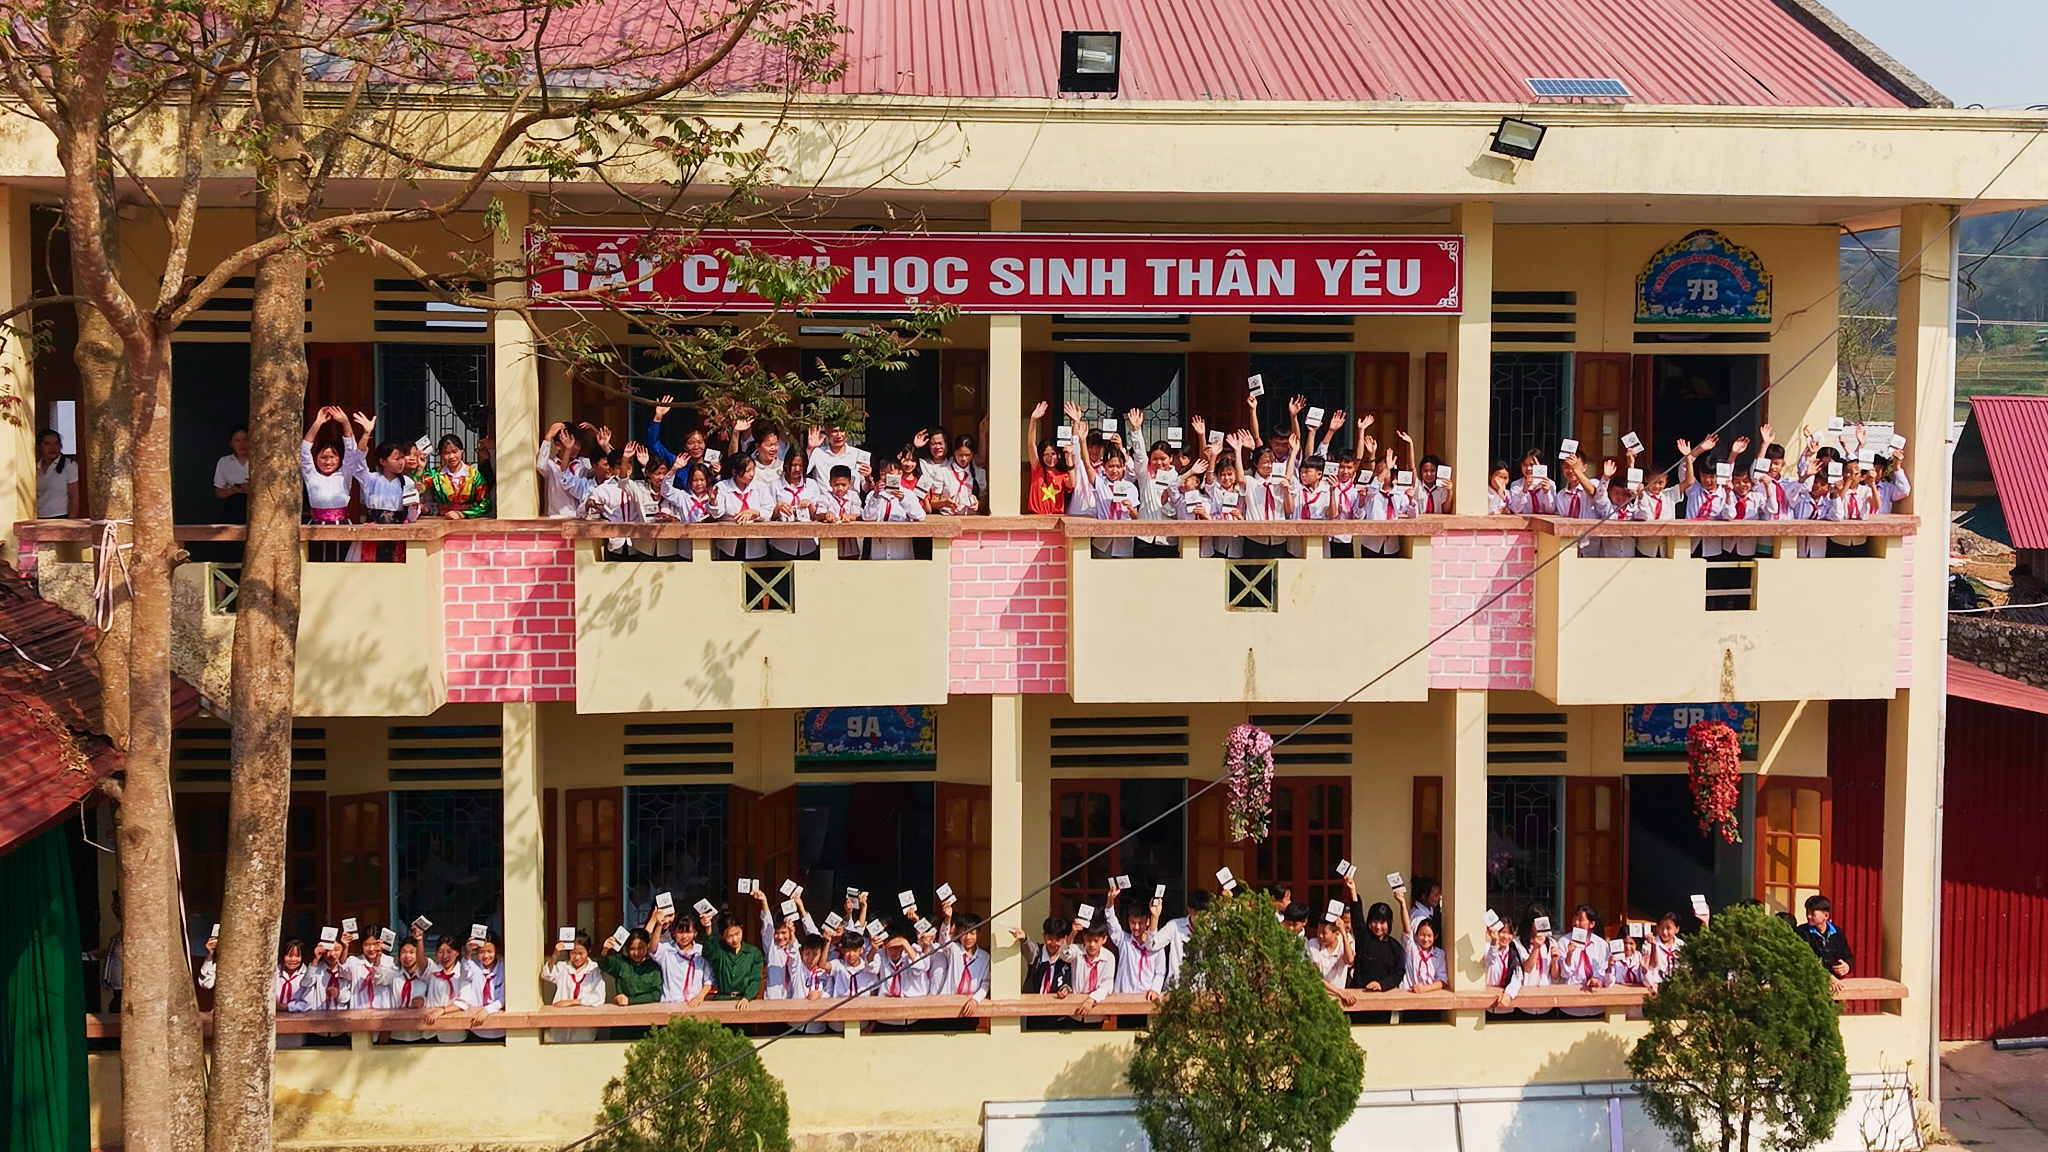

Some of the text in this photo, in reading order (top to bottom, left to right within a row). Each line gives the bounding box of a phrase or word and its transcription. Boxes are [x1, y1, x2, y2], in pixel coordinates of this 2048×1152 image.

[853, 256, 968, 305] HỌC
[988, 257, 1127, 296] SINH
[1145, 249, 1297, 296] THÂN
[1316, 249, 1421, 296] YÊU
[1687, 279, 1718, 300] 7B
[848, 717, 881, 737] 9A
